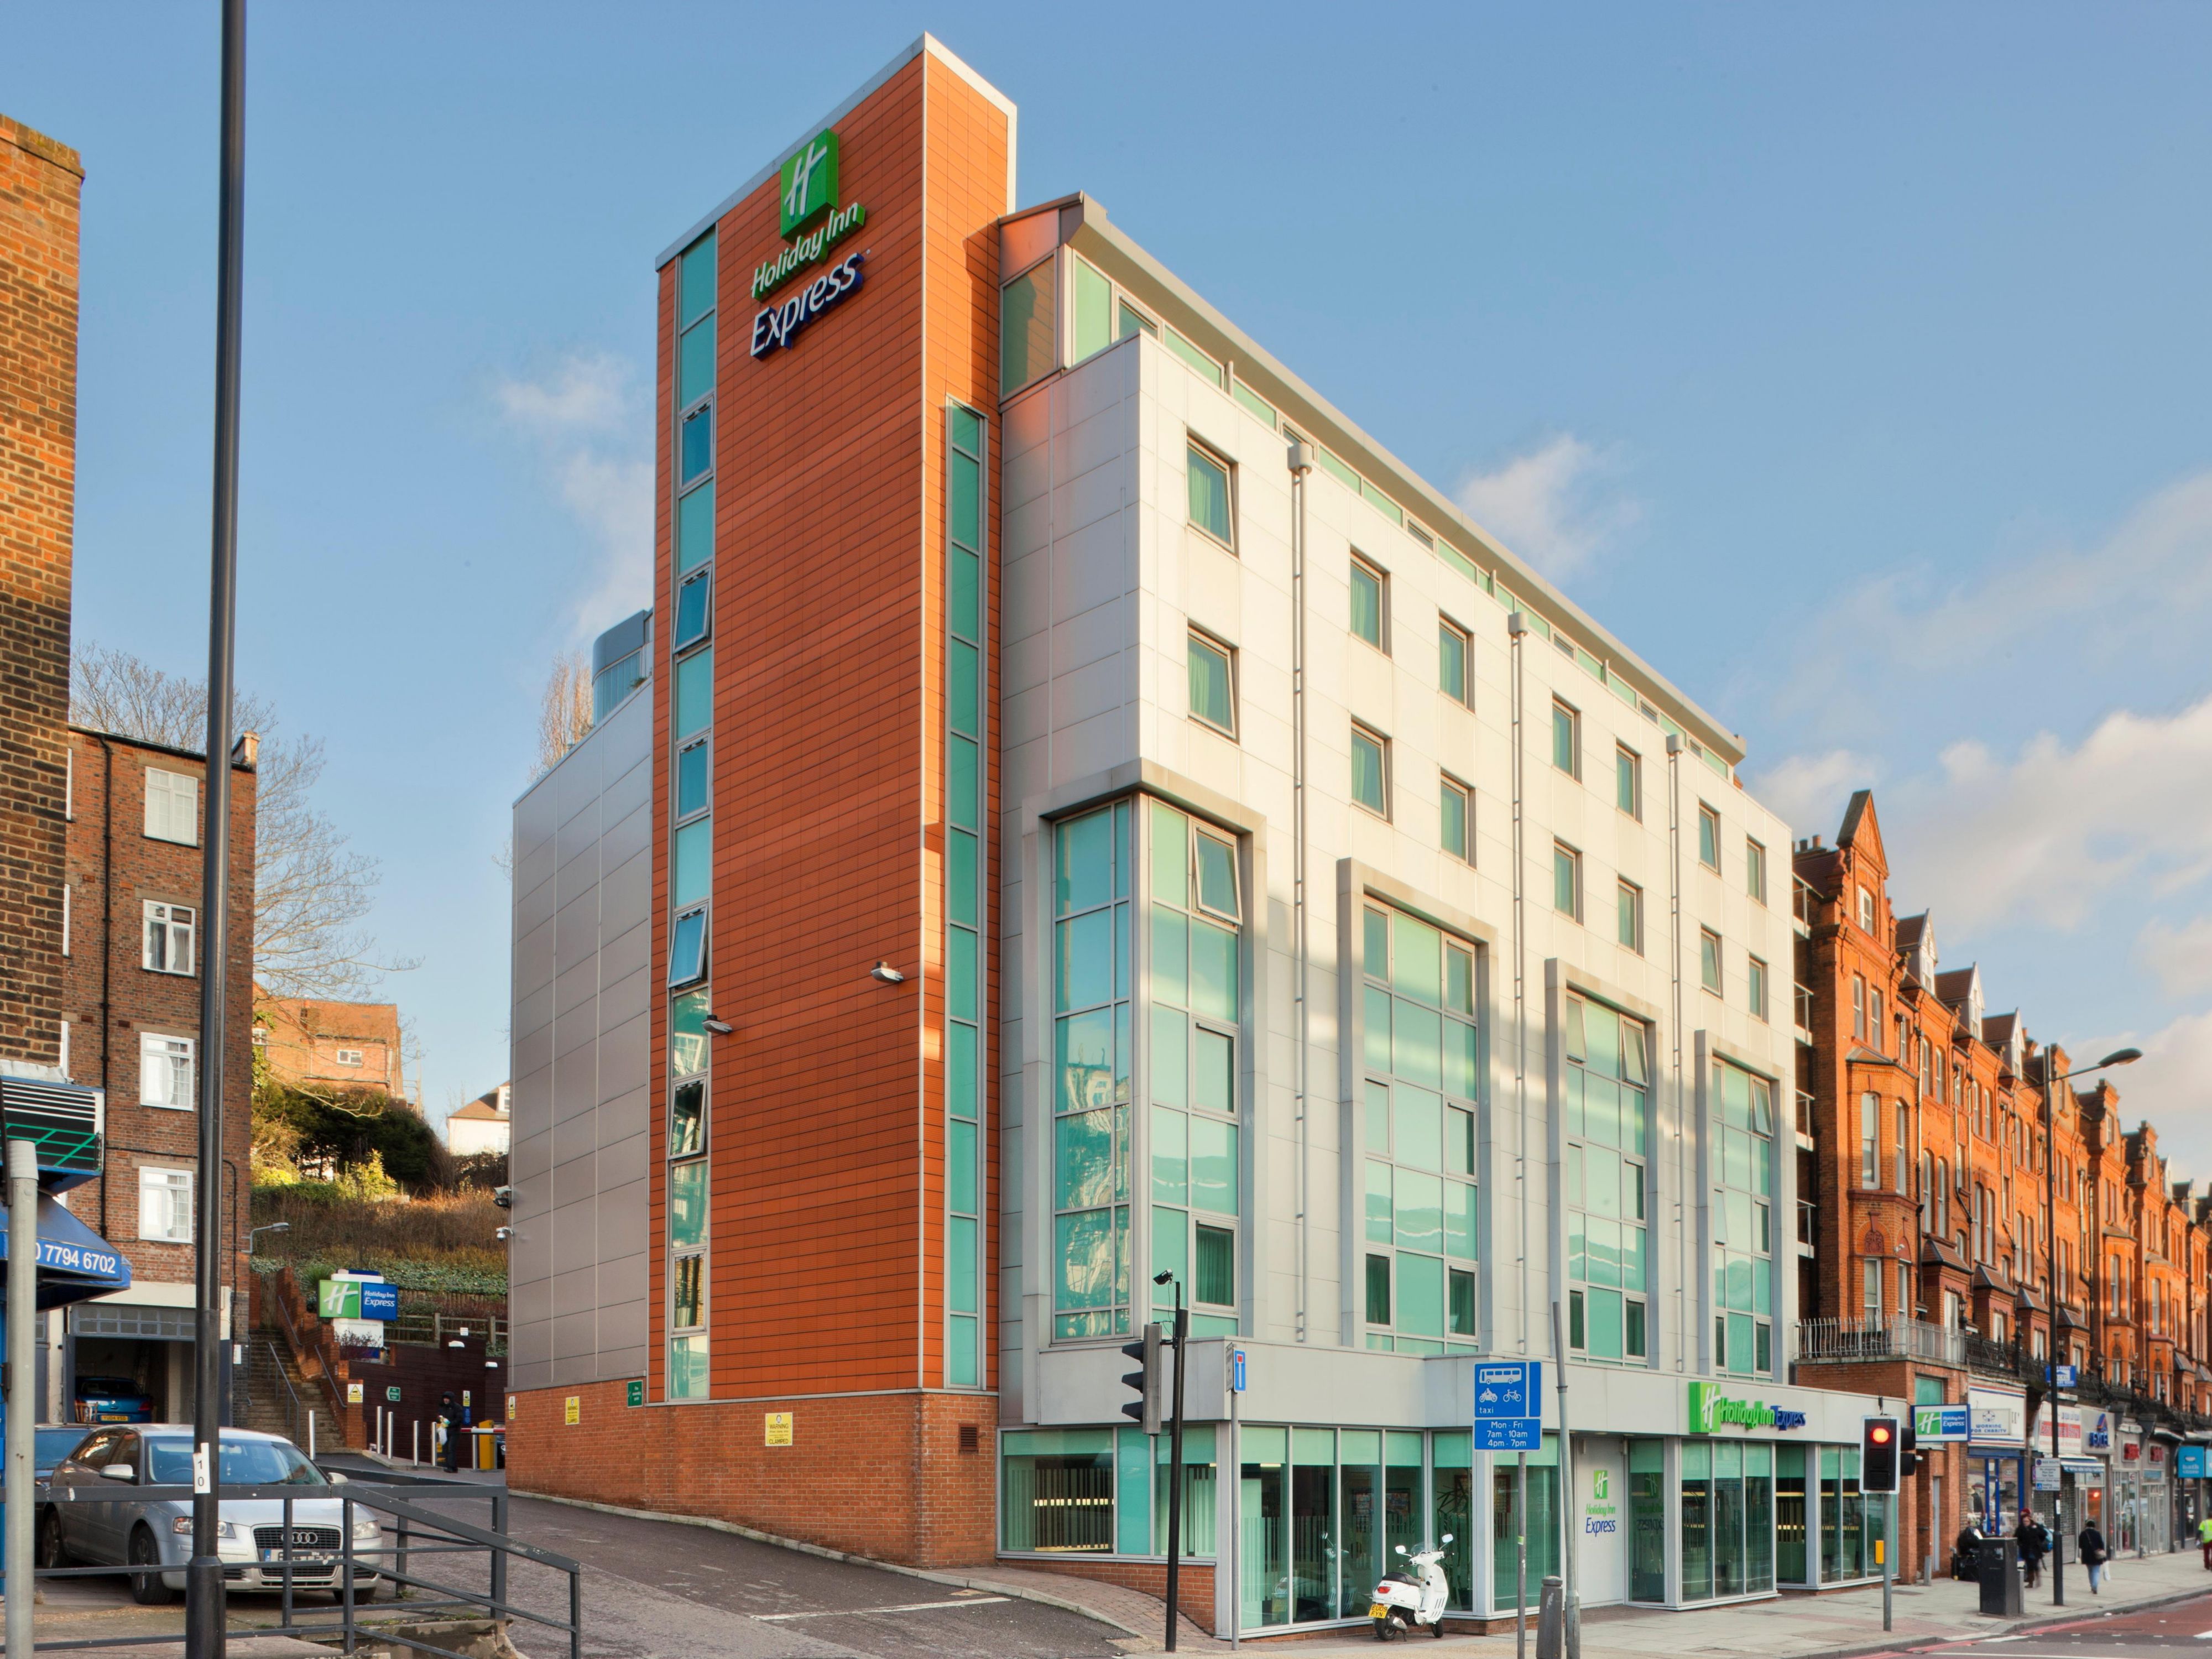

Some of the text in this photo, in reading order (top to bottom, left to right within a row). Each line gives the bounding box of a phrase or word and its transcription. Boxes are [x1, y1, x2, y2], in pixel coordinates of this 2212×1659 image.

[751, 202, 858, 299] Holiday Inn
[750, 253, 860, 357] Express
[45, 1244, 80, 1267] 7794
[83, 1252, 116, 1274] 6702
[364, 1290, 386, 1298] Holiday
[364, 1297, 395, 1307] Express
[1720, 1397, 1758, 1430] Holiday
[1775, 1406, 1806, 1431] Express
[1586, 1504, 1616, 1517] Holiday Inn
[1586, 1517, 1616, 1537] Express
